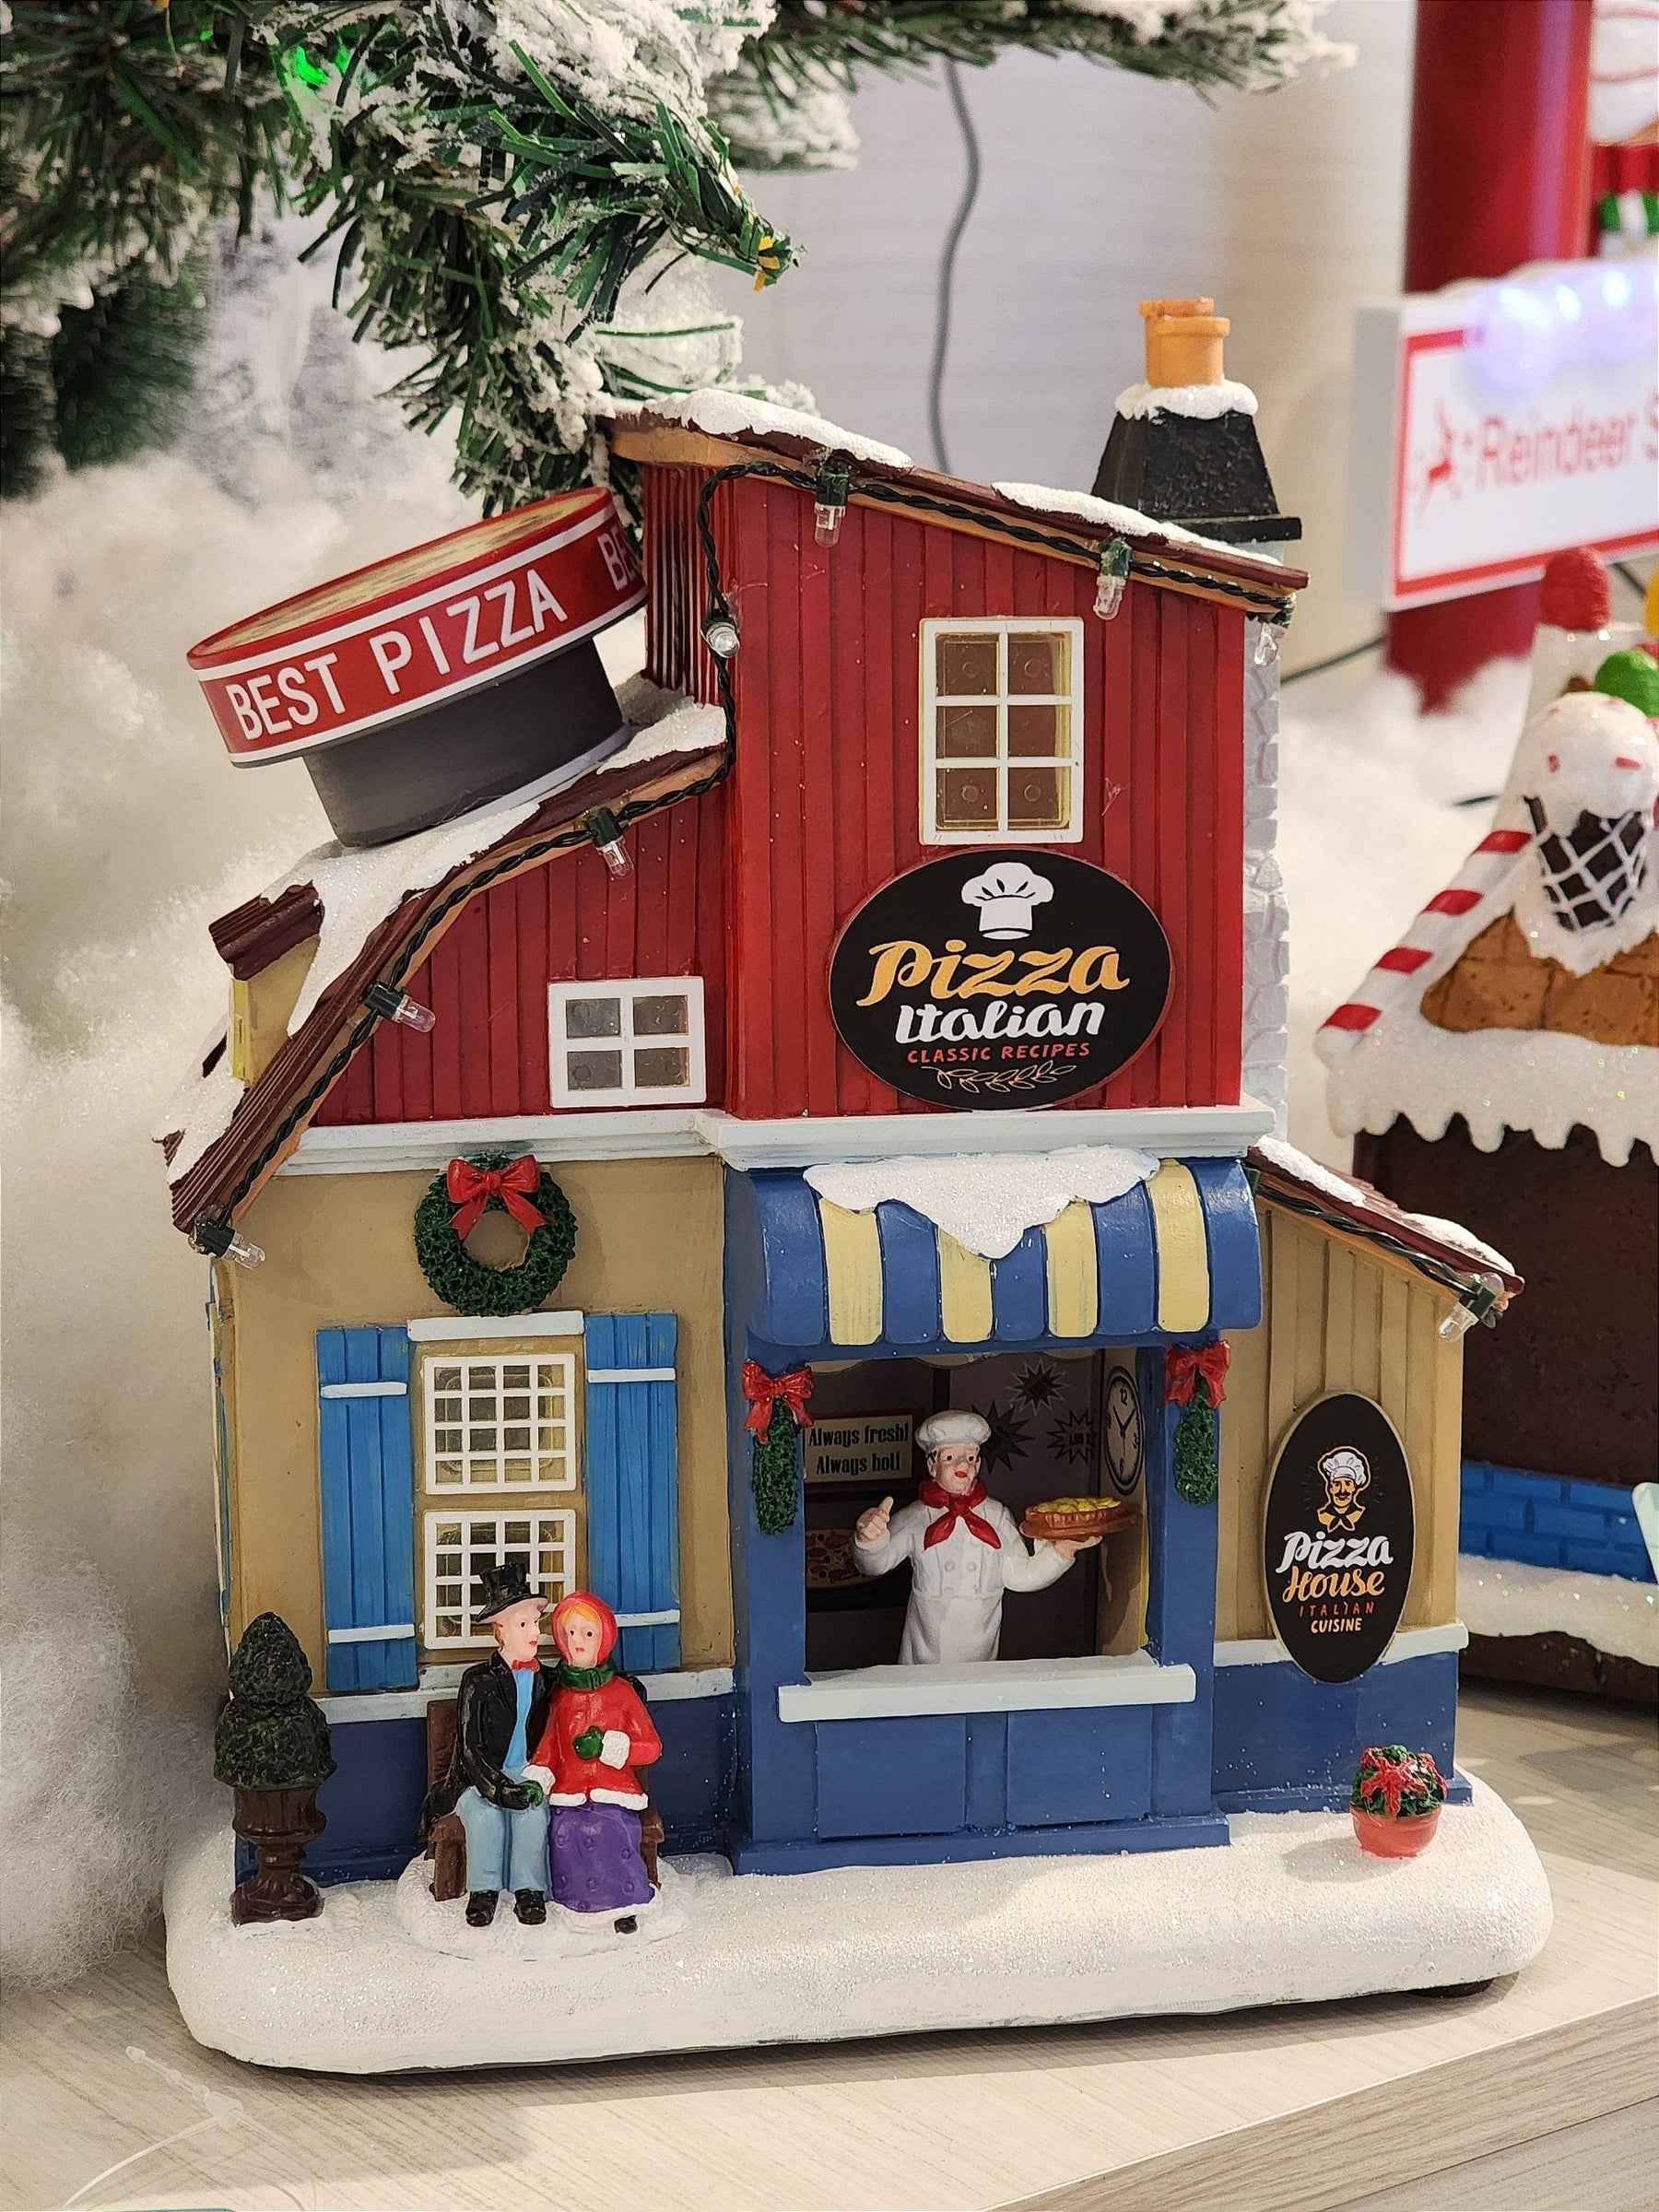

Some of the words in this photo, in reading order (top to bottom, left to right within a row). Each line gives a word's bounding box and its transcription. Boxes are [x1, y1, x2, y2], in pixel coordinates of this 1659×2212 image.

[225, 652, 346, 740] BEST
[369, 569, 569, 695] PIZZA
[856, 939, 1130, 1006] Pizza
[895, 1000, 1105, 1044] Italian
[907, 1047, 991, 1064] CLASSIC
[1001, 1042, 1090, 1059] RECIPES
[809, 1427, 860, 1448] Always
[864, 1422, 909, 1443] fresh!
[817, 1454, 867, 1476] Always
[871, 1451, 900, 1472] hot!
[1276, 1530, 1394, 1574] Pizza
[1282, 1565, 1385, 1603] House
[1299, 1600, 1374, 1618] ITALIAN
[1310, 1618, 1362, 1634] CUISINE
